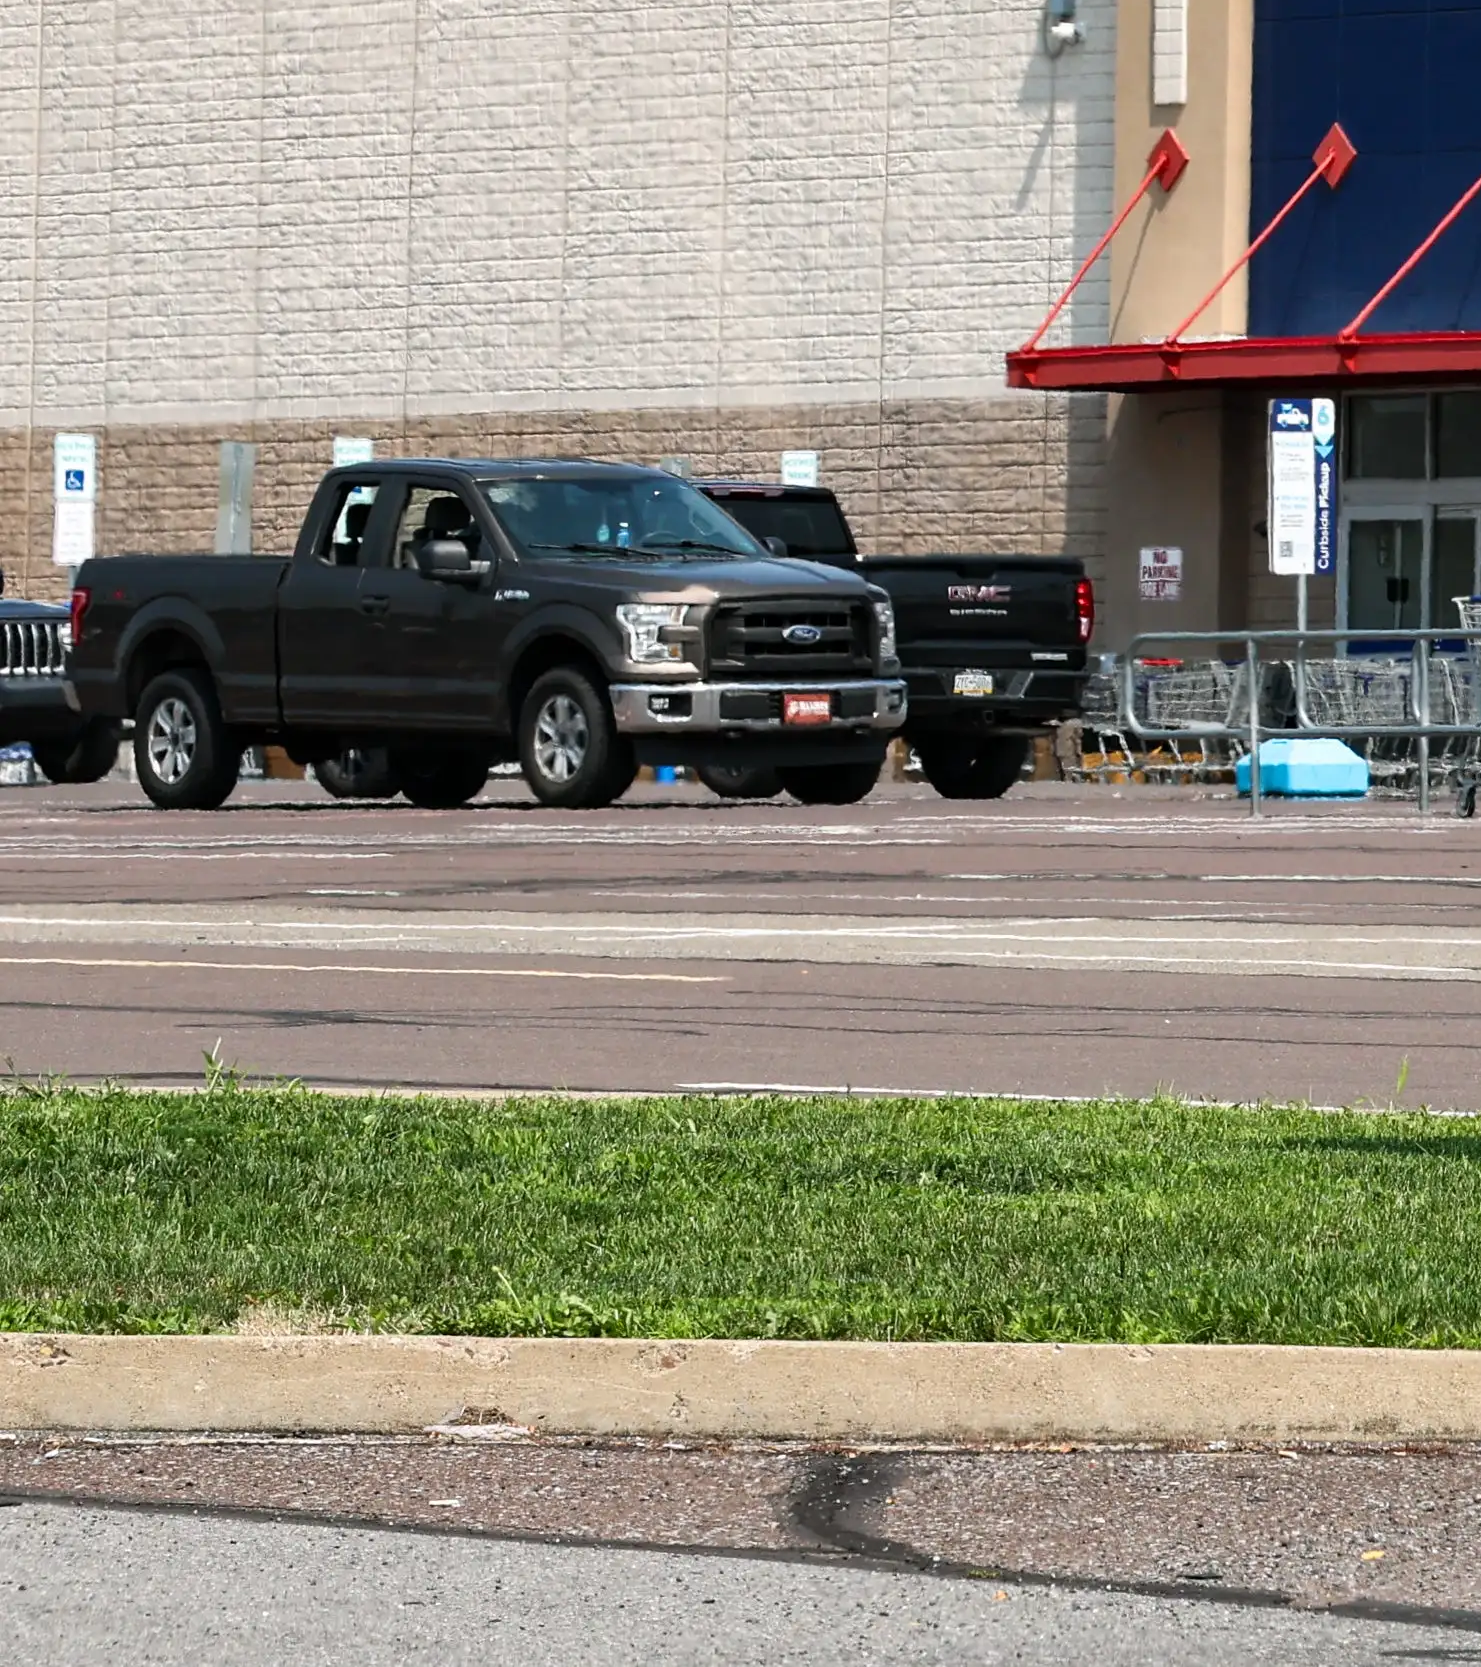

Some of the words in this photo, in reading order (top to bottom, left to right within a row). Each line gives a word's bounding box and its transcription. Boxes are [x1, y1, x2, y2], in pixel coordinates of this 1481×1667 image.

[1317, 406, 1329, 426] 6
[1318, 461, 1331, 508] Pickup
[1317, 510, 1330, 570] Curbside
[1152, 549, 1168, 565] NO
[1141, 565, 1179, 580] PARKING
